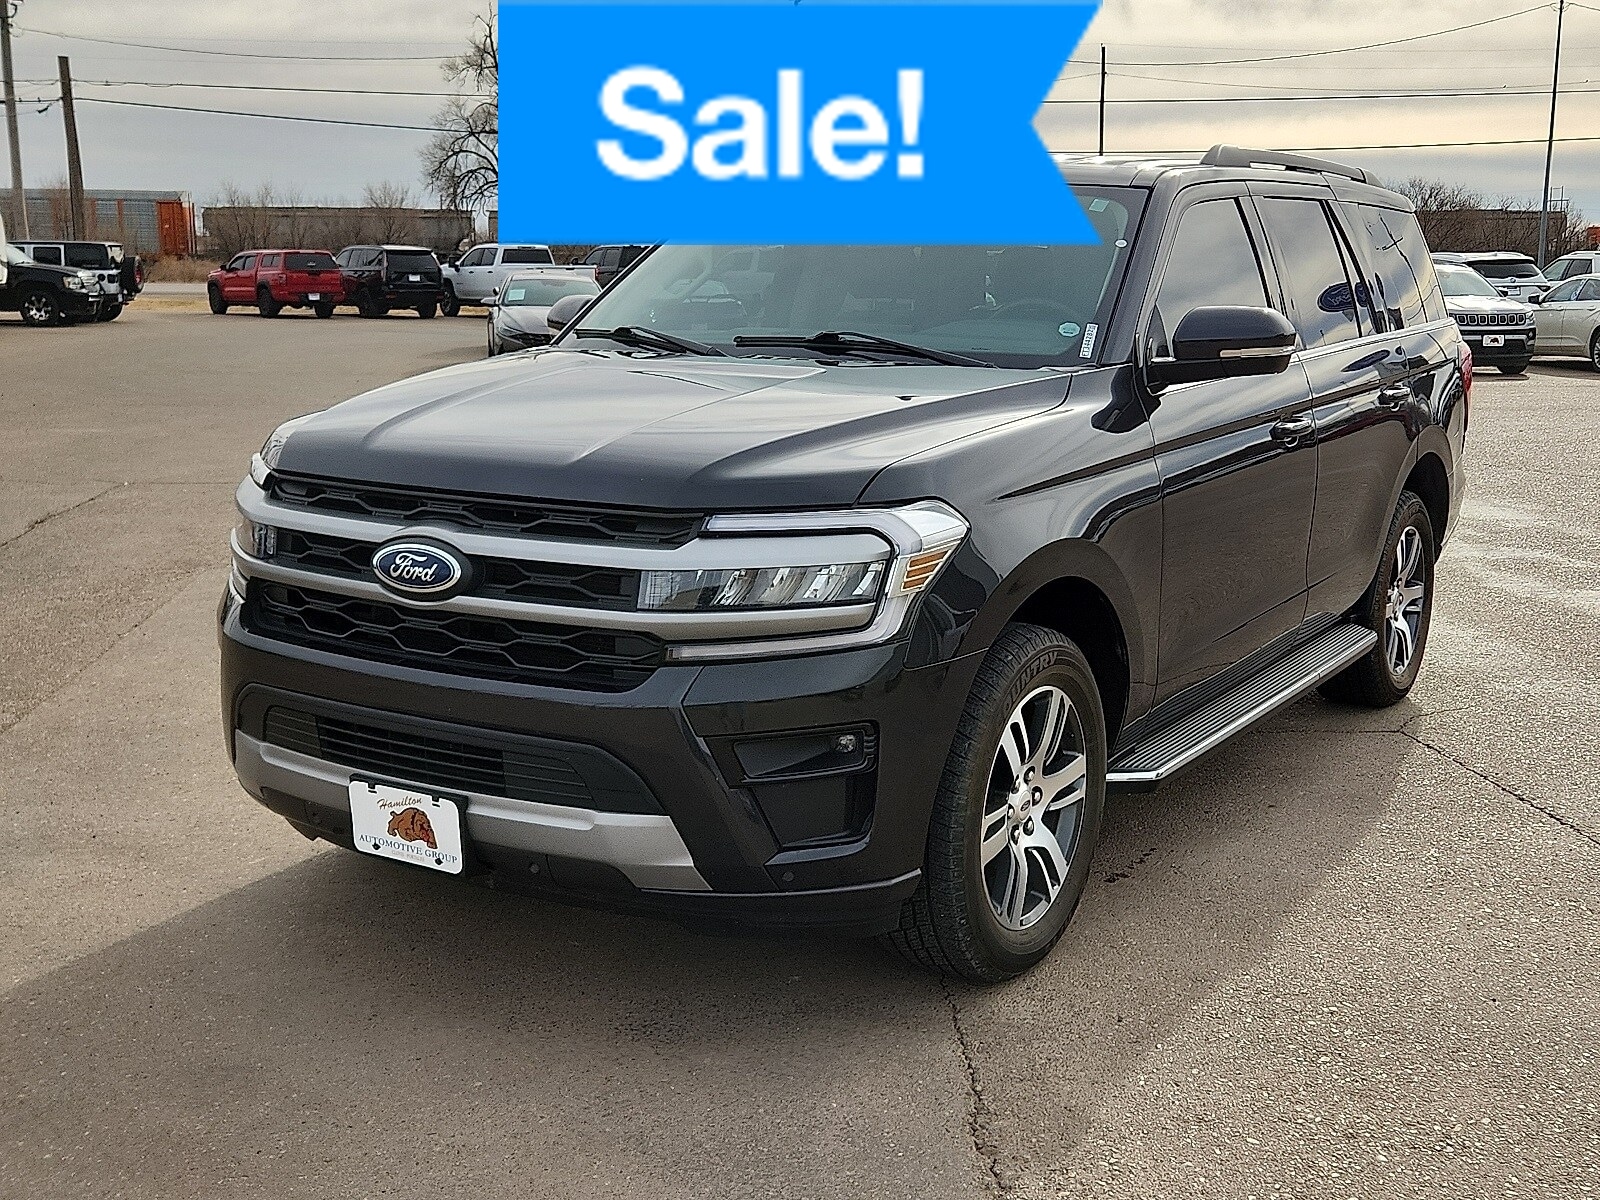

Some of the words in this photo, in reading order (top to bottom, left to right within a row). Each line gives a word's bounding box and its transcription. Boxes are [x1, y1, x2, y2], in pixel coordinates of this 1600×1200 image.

[390, 552, 439, 582] Ford
[376, 796, 422, 810] Hamilton
[359, 834, 423, 856] AUTOMOTIVE
[424, 849, 458, 864] GROUP
